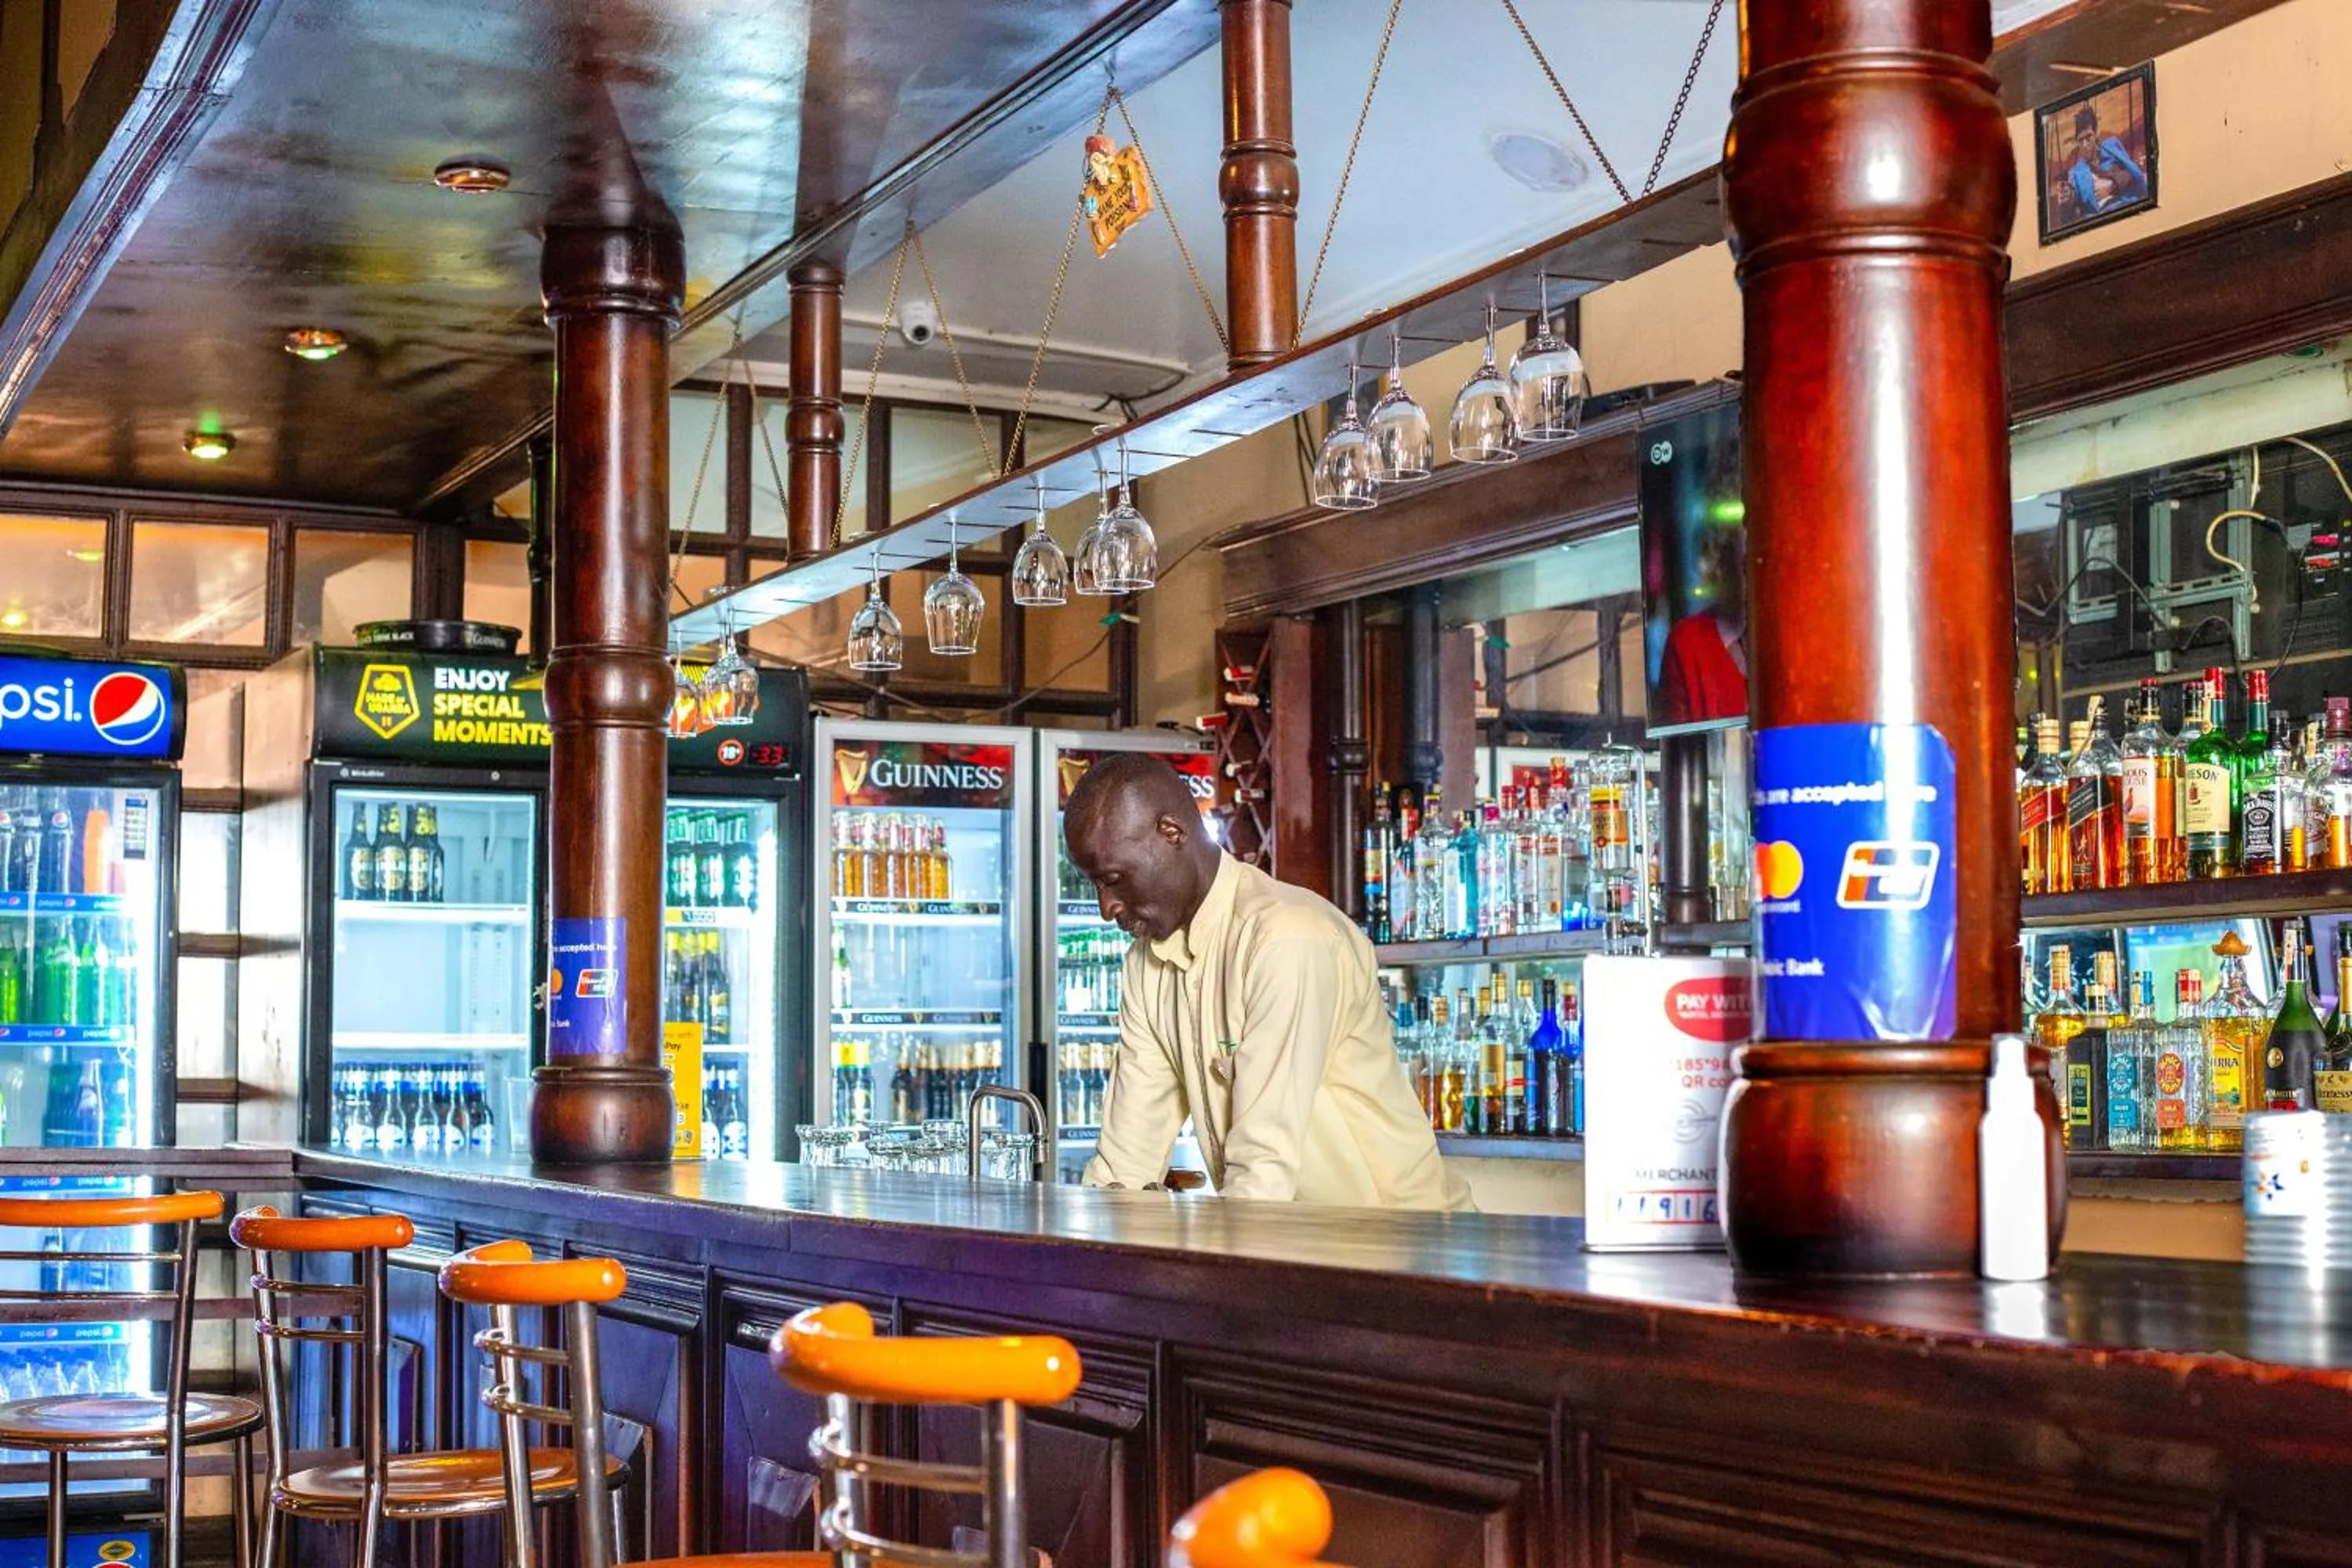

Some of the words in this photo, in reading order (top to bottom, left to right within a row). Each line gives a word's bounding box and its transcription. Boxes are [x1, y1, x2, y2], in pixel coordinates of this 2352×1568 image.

[434, 666, 510, 691] ENJOY
[433, 693, 525, 718] SPECIAL
[433, 719, 554, 746] MOMENTS
[870, 758, 1004, 789] GUINNESS
[1791, 781, 1885, 806] accepted
[560, 943, 595, 953] accepted
[1676, 993, 1709, 1010] PAY
[1682, 1075, 1704, 1088] QR
